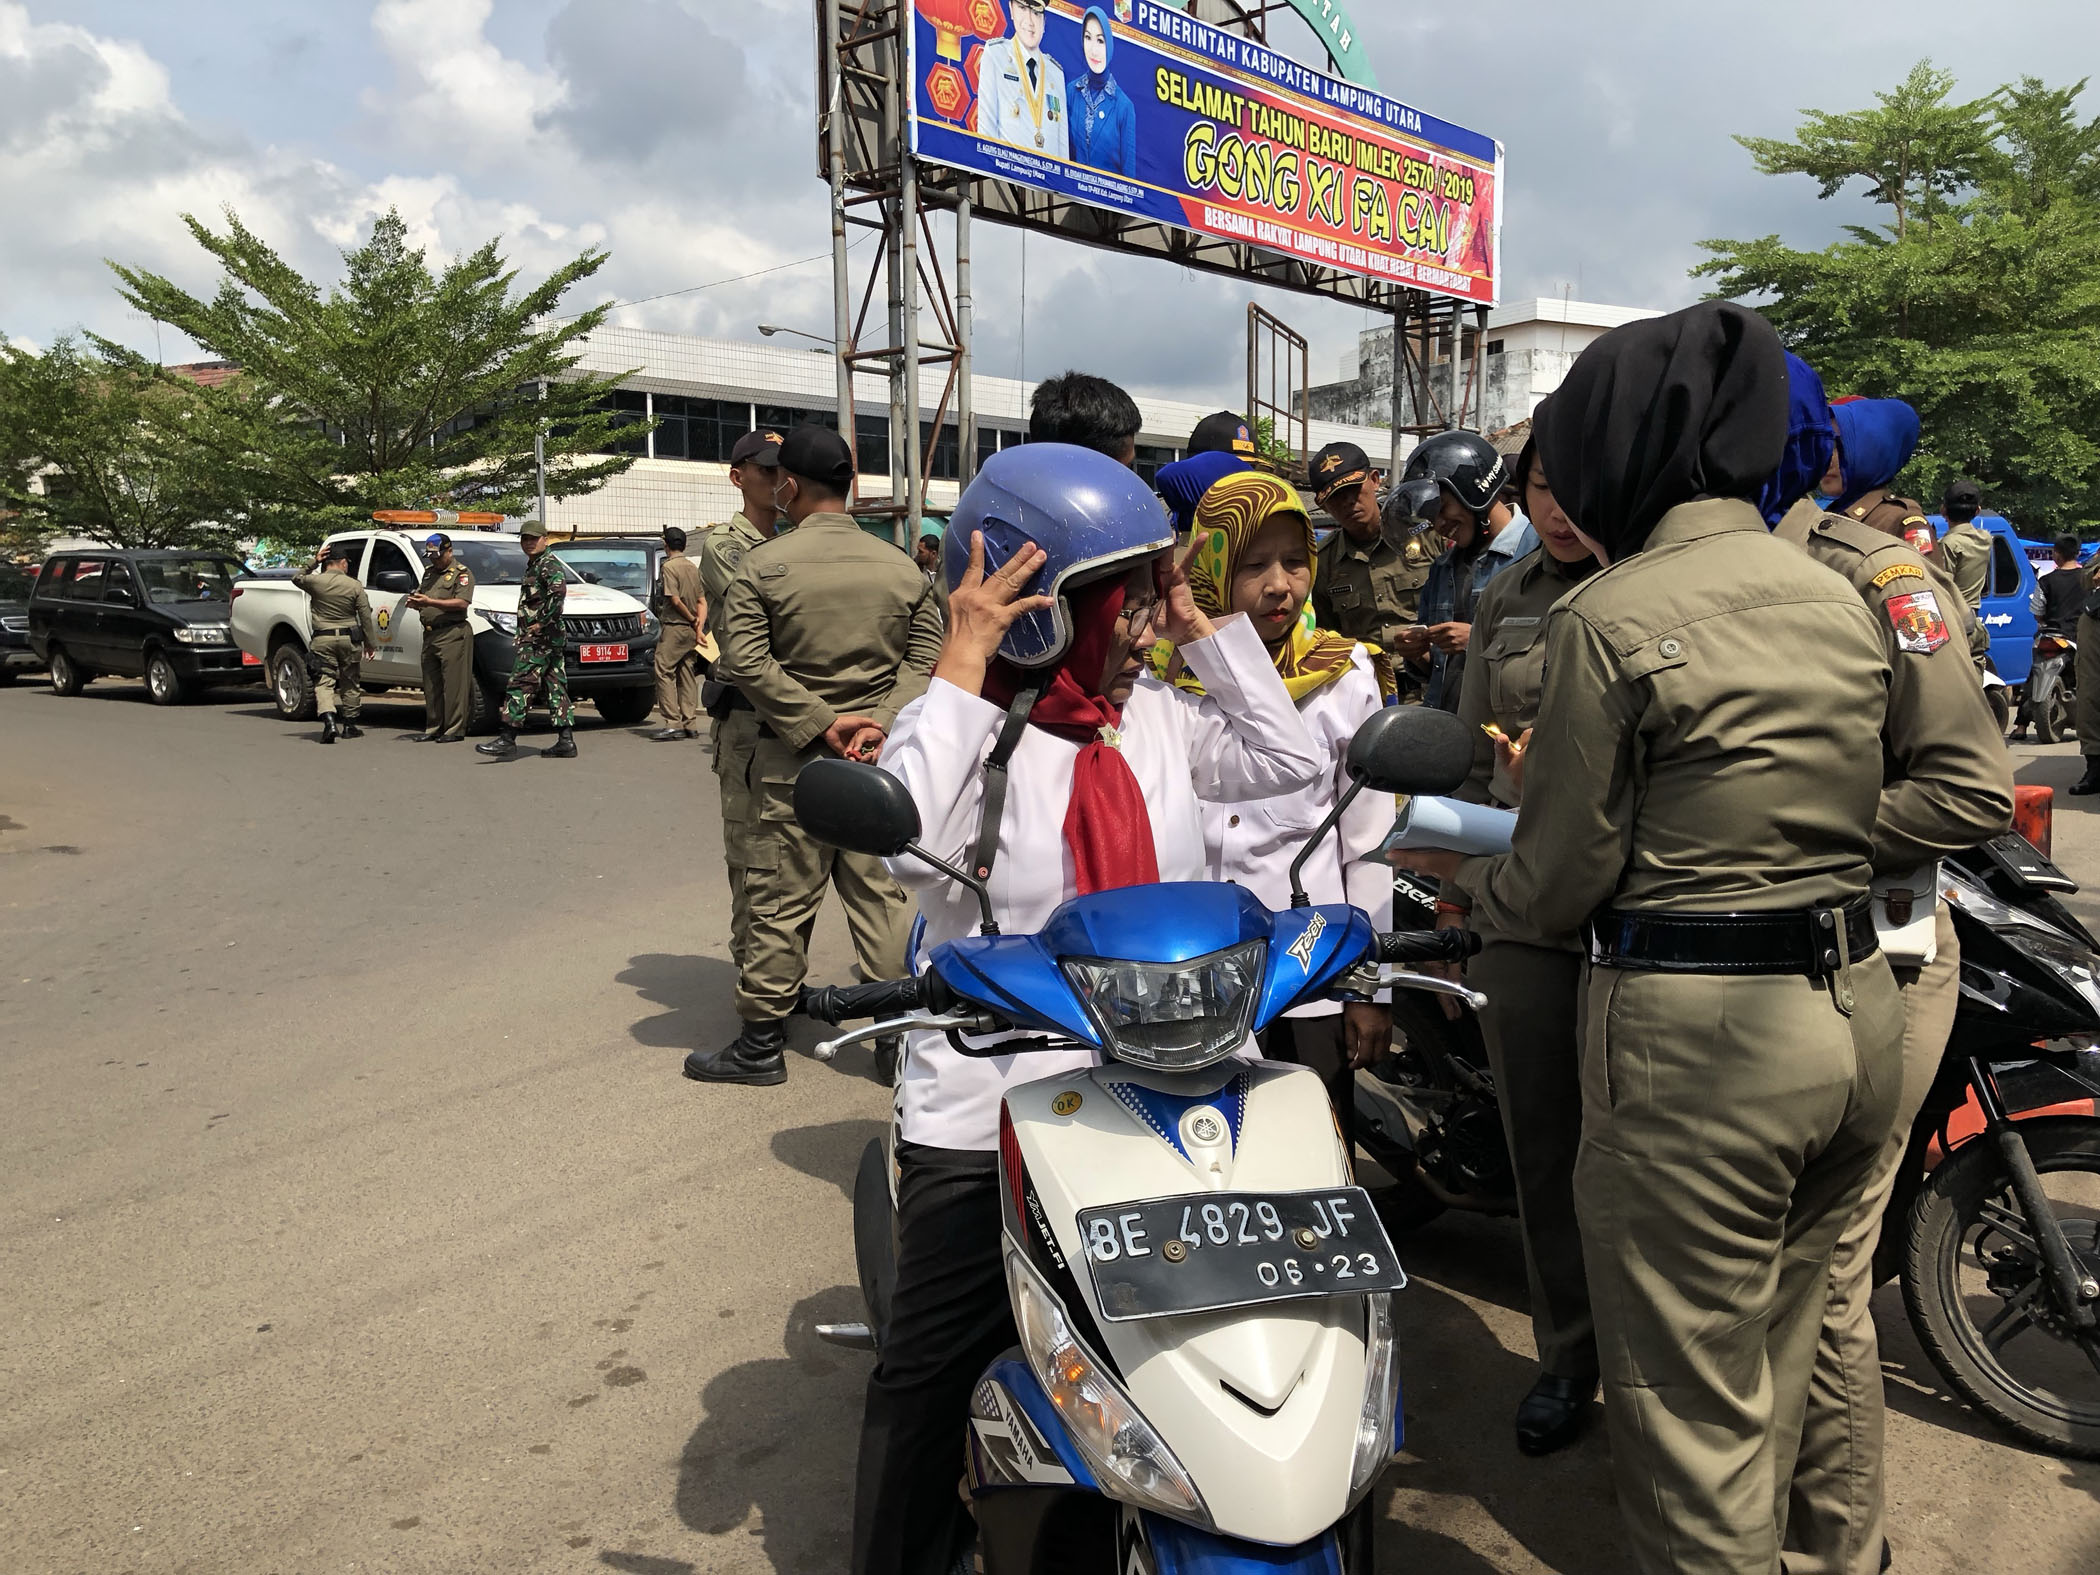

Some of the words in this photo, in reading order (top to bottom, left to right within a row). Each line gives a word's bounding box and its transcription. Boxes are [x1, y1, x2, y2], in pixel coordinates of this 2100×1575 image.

[1138, 2, 1236, 62] PEMERINTAH
[1241, 44, 1320, 95] KABUPATEN
[1323, 79, 1382, 118] LAMPUNG
[1385, 102, 1422, 133] UTARA
[1156, 67, 1245, 127] SELAMAT
[1248, 100, 1305, 149] TAHUN
[1309, 121, 1353, 165] BARU
[1356, 140, 1402, 182] IMLEK
[1403, 156, 1435, 193] 2570
[1444, 171, 1474, 206] 2019
[1011, 163, 1033, 177] Lampung
[1033, 170, 1046, 180] Utara
[1186, 122, 1301, 212] GONG
[1307, 160, 1345, 227] XI
[1353, 178, 1391, 242] FA
[1398, 191, 1449, 254] CAI
[1204, 206, 1256, 238] BERSAMA
[1257, 220, 1293, 247] RAKYAT
[1294, 231, 1337, 260] LAMPUNG
[1339, 243, 1367, 269] UTARA
[582, 647, 591, 657] BE
[1057, 1098, 1075, 1111] OK
[1089, 1213, 1151, 1262] BE
[1179, 1201, 1284, 1249] 4829
[1311, 1199, 1355, 1239] JF
[1005, 1406, 1033, 1470] YAMAHA
